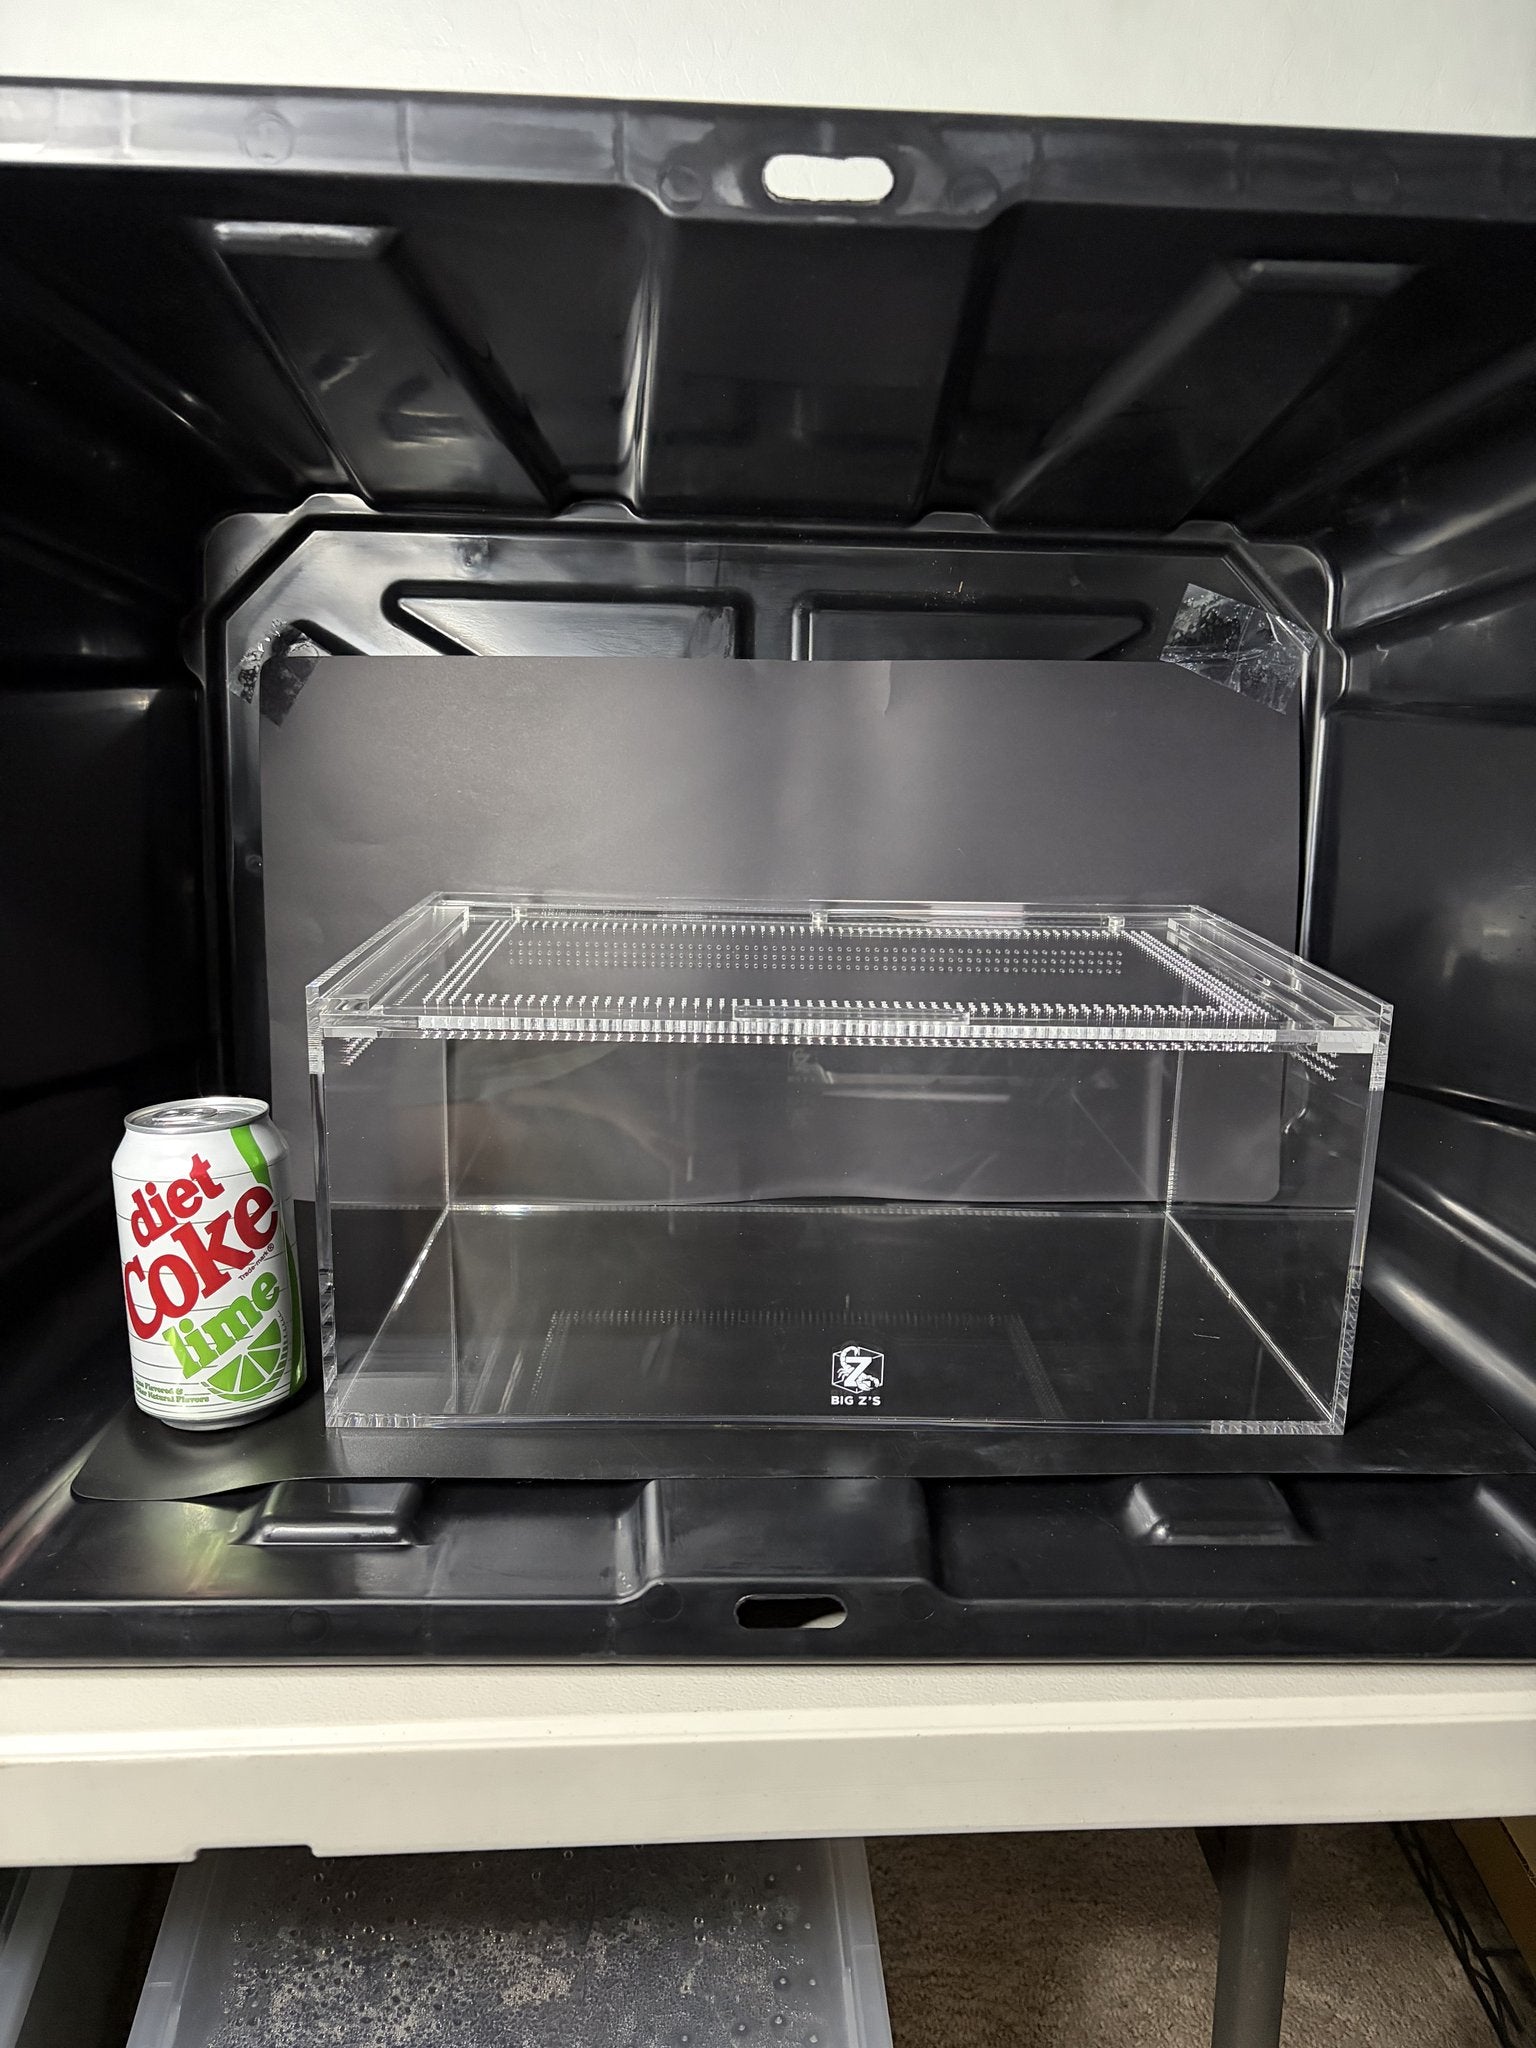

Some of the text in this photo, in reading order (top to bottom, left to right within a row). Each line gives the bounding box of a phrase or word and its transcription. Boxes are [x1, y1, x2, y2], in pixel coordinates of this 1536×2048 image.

[131, 1153, 225, 1248] diet
[125, 1186, 279, 1340] Coke
[162, 1272, 280, 1379] lime
[831, 1395, 881, 1406] BIG Z'S
